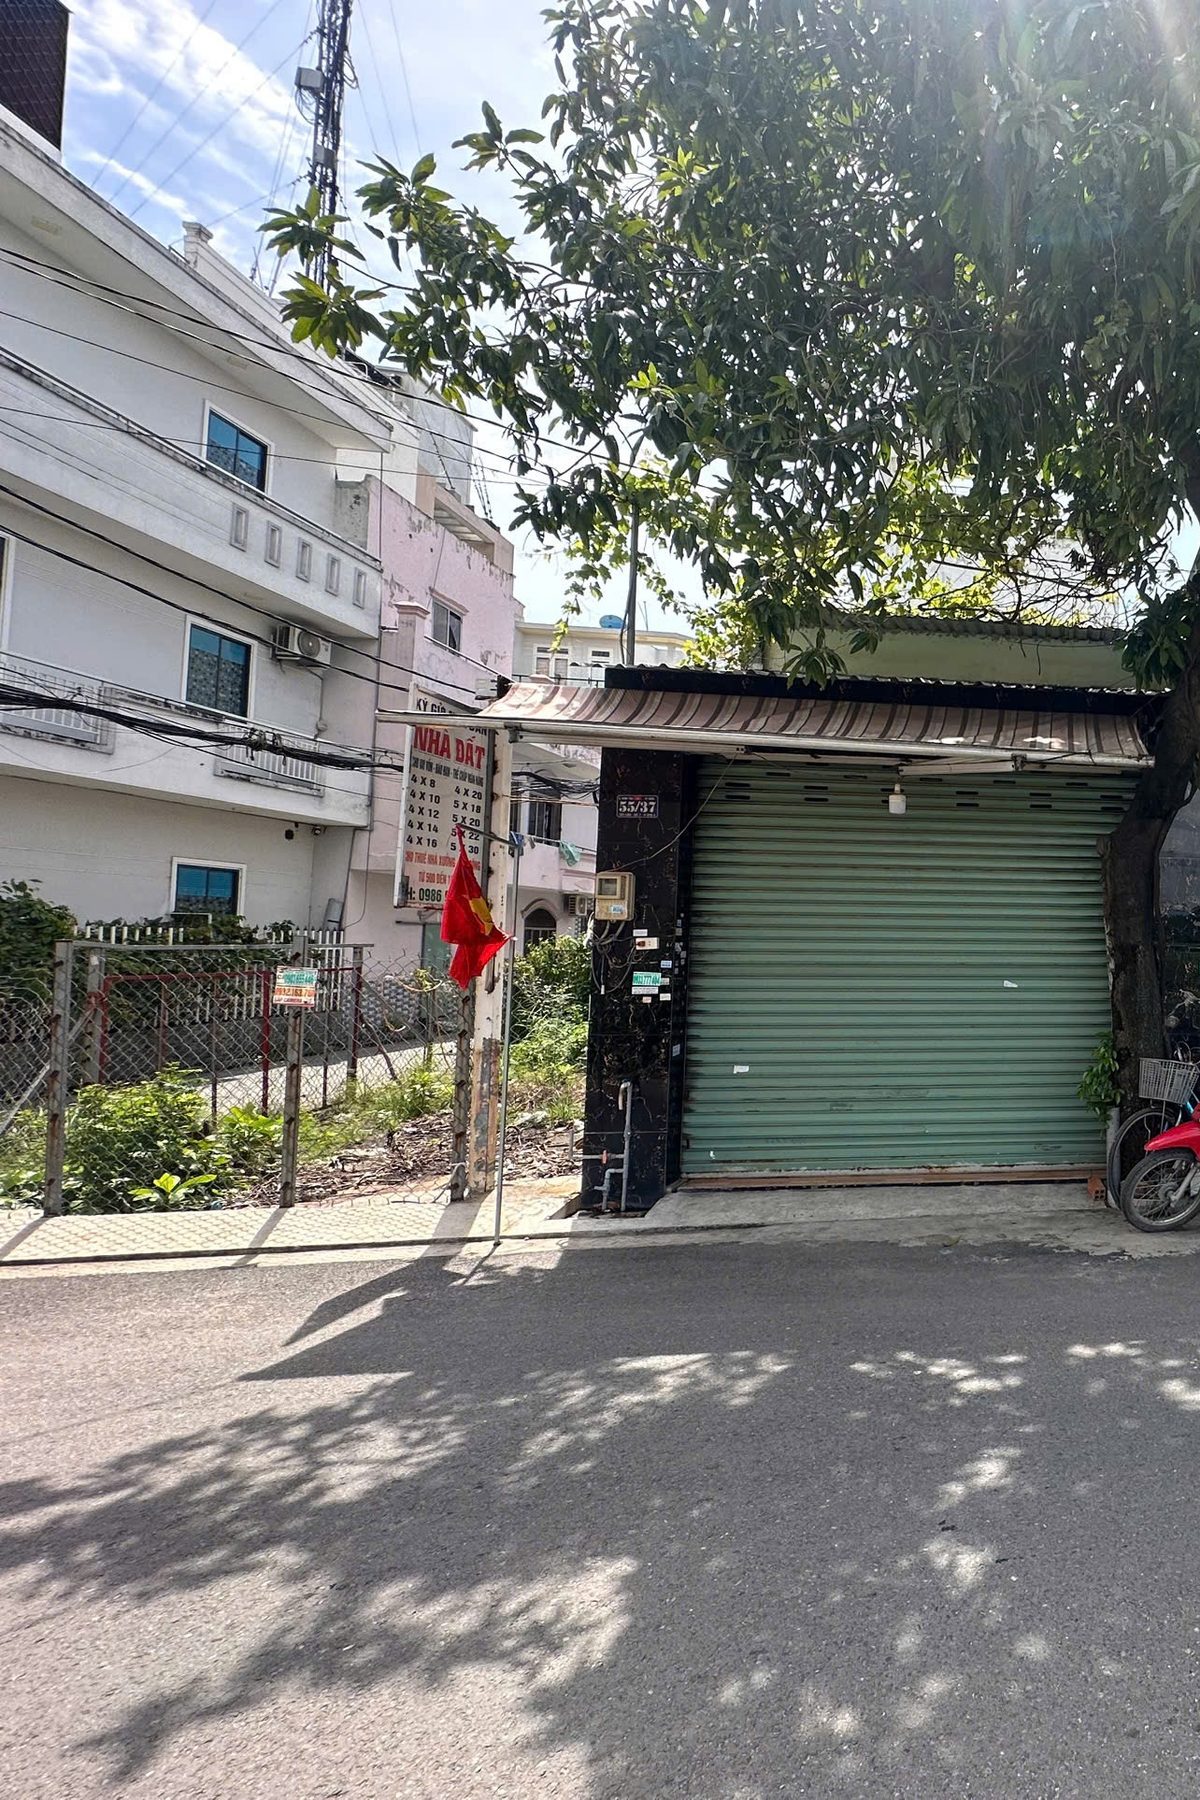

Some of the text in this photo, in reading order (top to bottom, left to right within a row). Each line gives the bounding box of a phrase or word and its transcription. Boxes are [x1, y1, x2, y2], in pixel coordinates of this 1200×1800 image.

[414, 725, 451, 760] NHÀ
[455, 736, 485, 770] ĐẤT
[410, 774, 436, 788] 4 X 8
[409, 789, 441, 804] 4 X 10
[454, 785, 483, 800] 4 X 20
[408, 804, 440, 819] 4 X 12
[453, 799, 481, 814] 5 X 18
[619, 800, 656, 813] 55/37
[407, 819, 439, 833] 4 X 14
[452, 813, 481, 828] 5 X 20
[406, 834, 438, 848] 4 X 16
[451, 828, 457, 837] 5
[469, 831, 480, 841] 22
[450, 842, 456, 851] 5
[468, 845, 479, 855] 30
[418, 887, 442, 902] 0986
